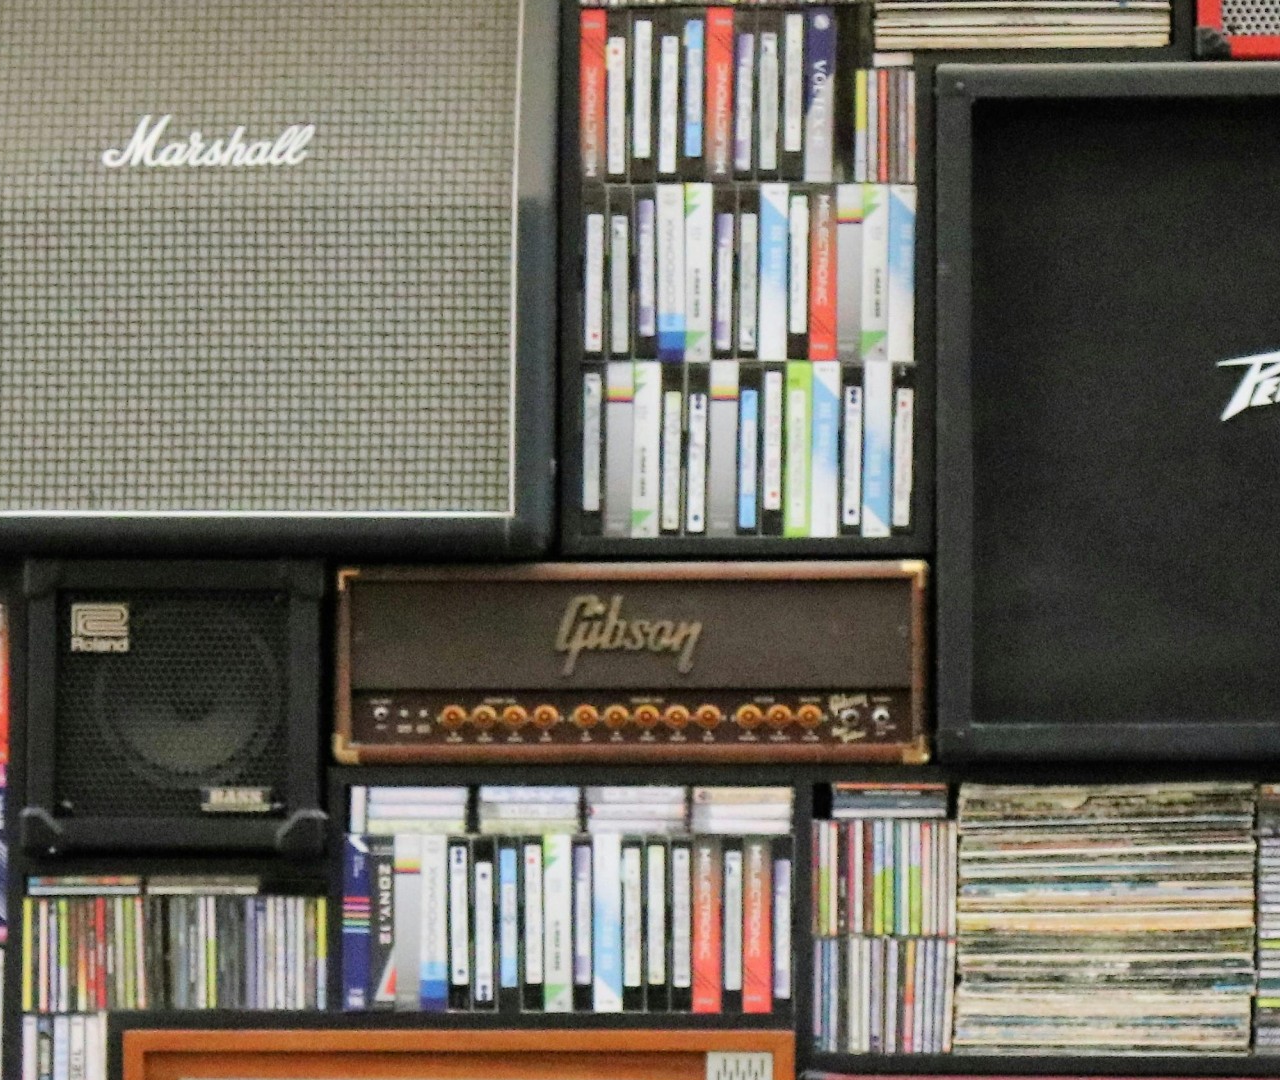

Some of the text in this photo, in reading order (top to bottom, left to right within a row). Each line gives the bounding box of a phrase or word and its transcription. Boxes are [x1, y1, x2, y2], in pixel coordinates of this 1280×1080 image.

[102, 115, 316, 168] Marshall
[70, 636, 129, 652] Roland
[556, 593, 704, 677] Gibson
